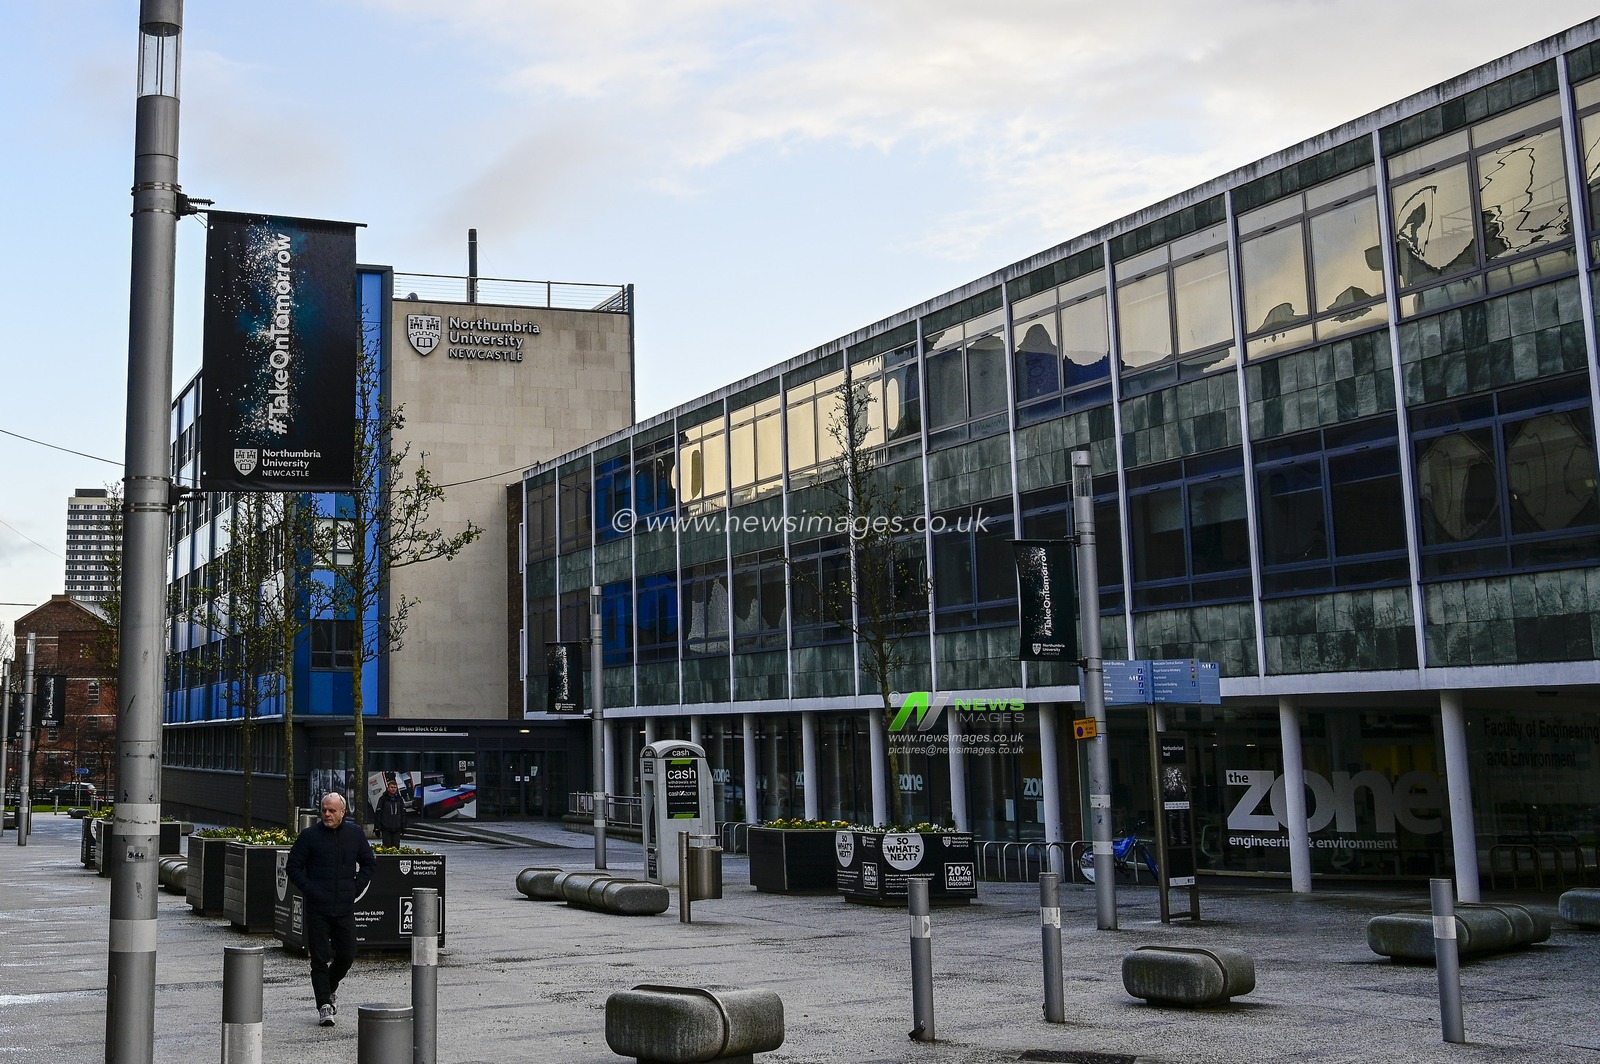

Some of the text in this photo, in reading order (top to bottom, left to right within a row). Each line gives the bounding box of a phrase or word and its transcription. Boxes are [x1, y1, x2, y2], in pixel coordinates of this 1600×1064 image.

[448, 316, 541, 334] Northumbria
[267, 233, 291, 435] #TakeOnTomorrow
[448, 331, 524, 350] University
[448, 348, 524, 361] NEWCASTLE
[262, 448, 321, 459] Northumbria
[262, 458, 310, 470] University
[1039, 547, 1053, 637] #TakeOnTomorrow
[1483, 717, 1600, 744] Faculty of Engineering
[671, 749, 690, 757] cash
[1487, 748, 1578, 768] and Environment
[667, 767, 696, 780] cash
[712, 768, 731, 783] zone
[1228, 772, 1249, 784] the
[1023, 777, 1043, 797] zon
[1226, 770, 1444, 835] zone
[896, 837, 909, 845] SO
[1229, 836, 1290, 850] engineerin
[1316, 838, 1399, 850] environment
[886, 845, 920, 853] WHAT'S
[890, 853, 918, 861] NEXT?
[947, 865, 972, 876] 20%
